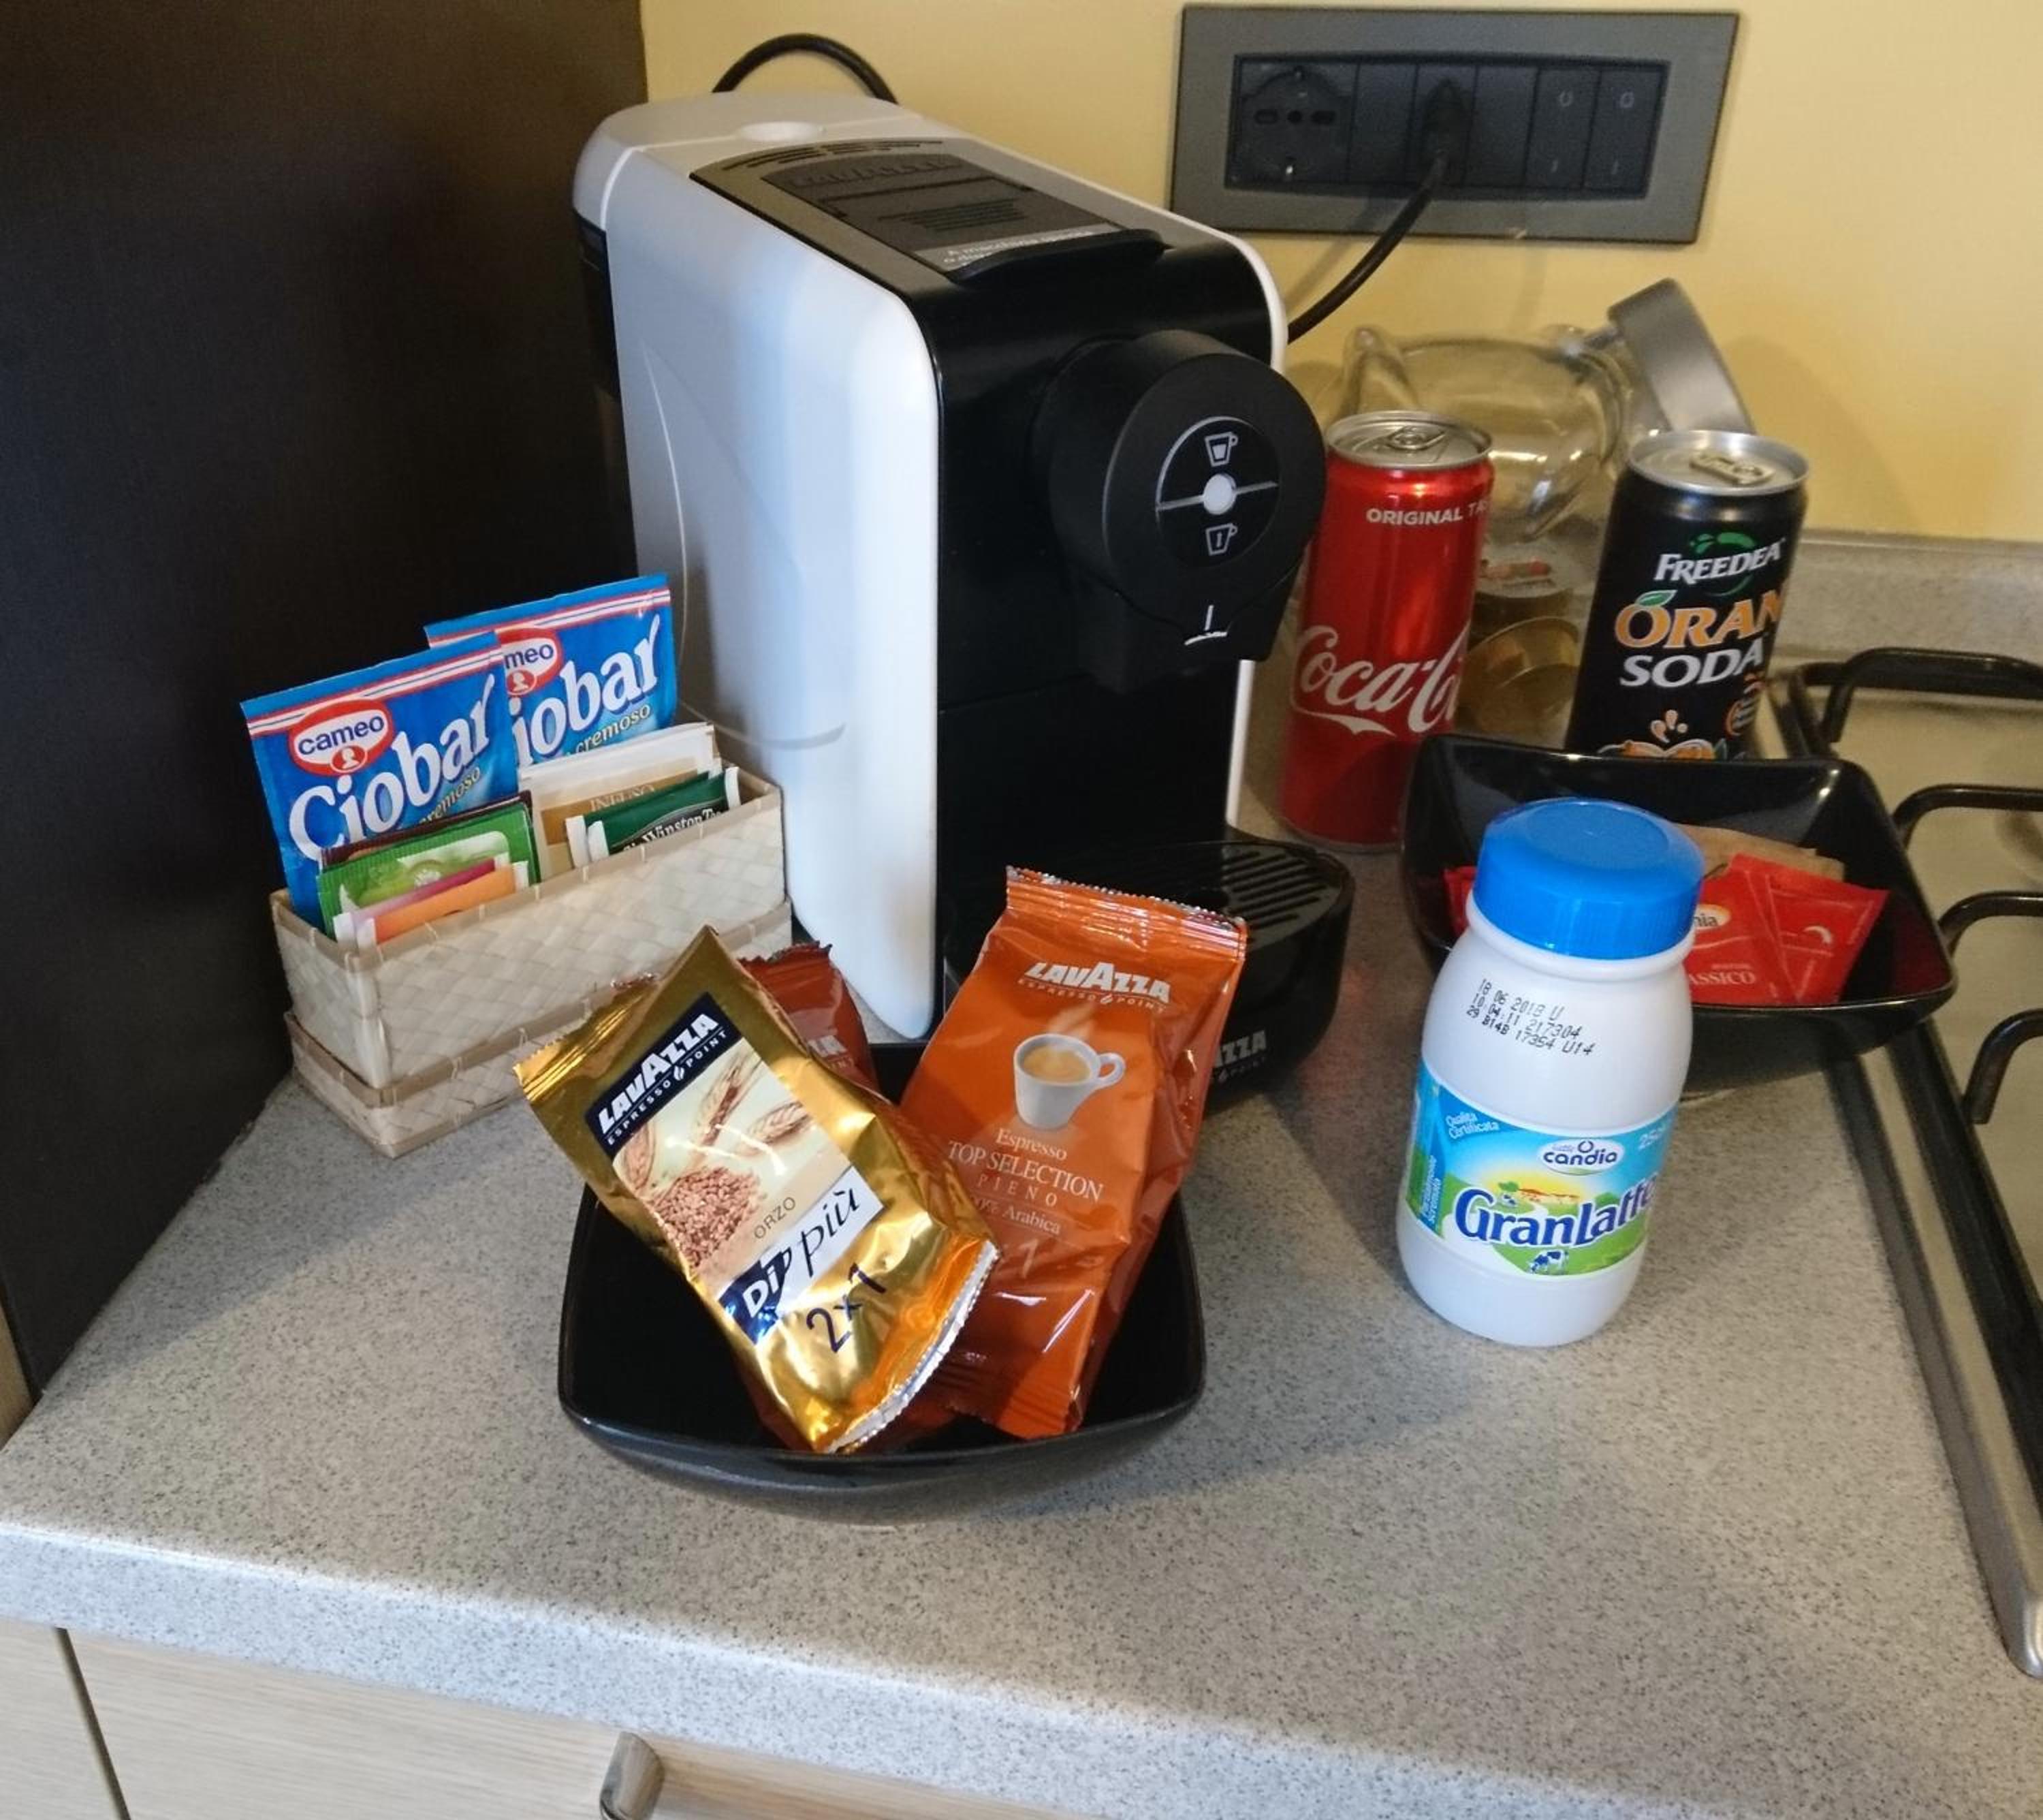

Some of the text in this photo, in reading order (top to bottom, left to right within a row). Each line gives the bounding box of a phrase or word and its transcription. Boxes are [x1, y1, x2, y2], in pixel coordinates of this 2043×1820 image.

[1366, 507, 1463, 526] ORIGINAL
[1653, 540, 1783, 585] FREEDEA
[505, 643, 554, 670] meo
[1619, 636, 1765, 688] SODA
[509, 614, 661, 768] iobar
[297, 715, 385, 756] cameo
[289, 673, 496, 862] Ciobar
[1024, 960, 1171, 1004] LAVAZZA
[1117, 997, 1167, 1014] POINT
[598, 1013, 719, 1135] LAVAZZA
[607, 1029, 727, 1146] ESPRESSO POINT
[995, 1127, 1068, 1161] Espresso
[1542, 1148, 1618, 1165] candia
[947, 1140, 1104, 1202] TOP SELECTION
[977, 1173, 1058, 1207] PIENO
[753, 1196, 797, 1240] ORZO
[798, 1187, 860, 1278] più
[1002, 1206, 1060, 1235] Arabica
